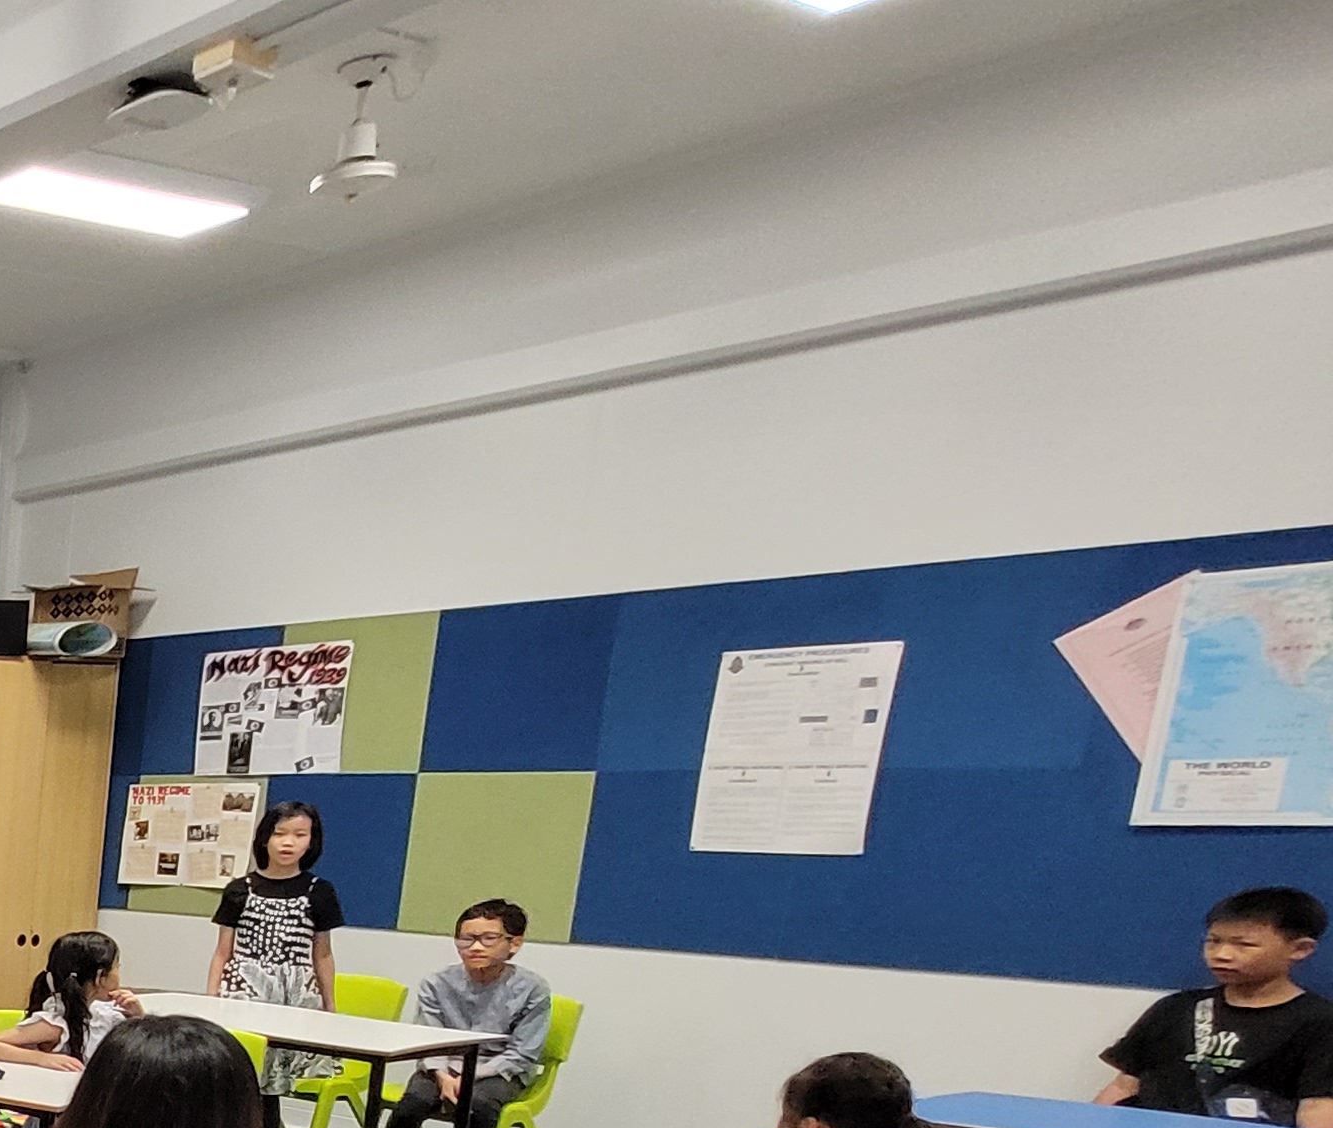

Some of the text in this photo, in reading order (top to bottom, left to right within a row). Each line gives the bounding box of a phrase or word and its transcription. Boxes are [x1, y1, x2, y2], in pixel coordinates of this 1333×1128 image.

[305, 667, 348, 685] 1939
[1185, 761, 1271, 770] THE WORLD
[133, 796, 144, 805] TO
